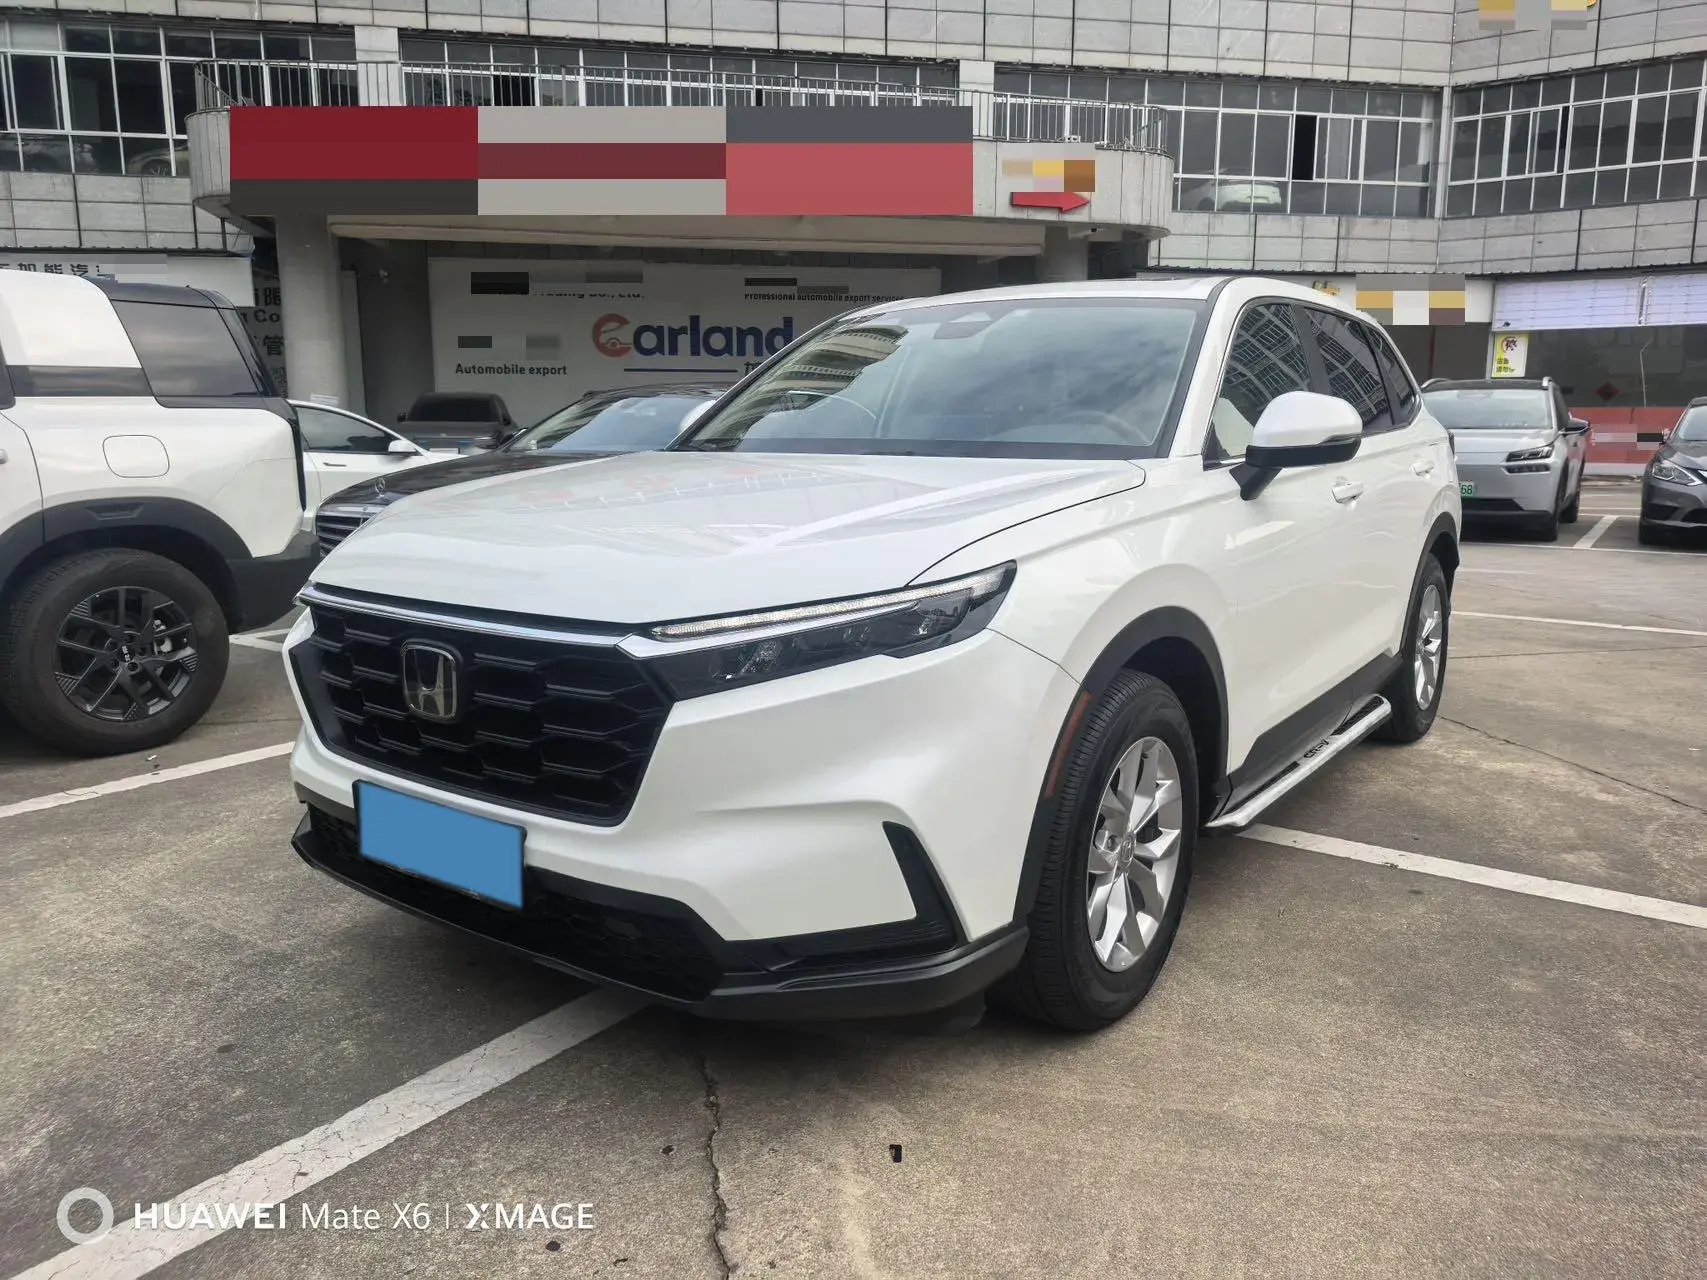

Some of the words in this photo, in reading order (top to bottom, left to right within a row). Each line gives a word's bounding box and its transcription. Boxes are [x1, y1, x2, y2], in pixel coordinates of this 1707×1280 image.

[844, 294, 870, 303] export
[455, 363, 526, 375] Automobile
[528, 365, 568, 376] export
